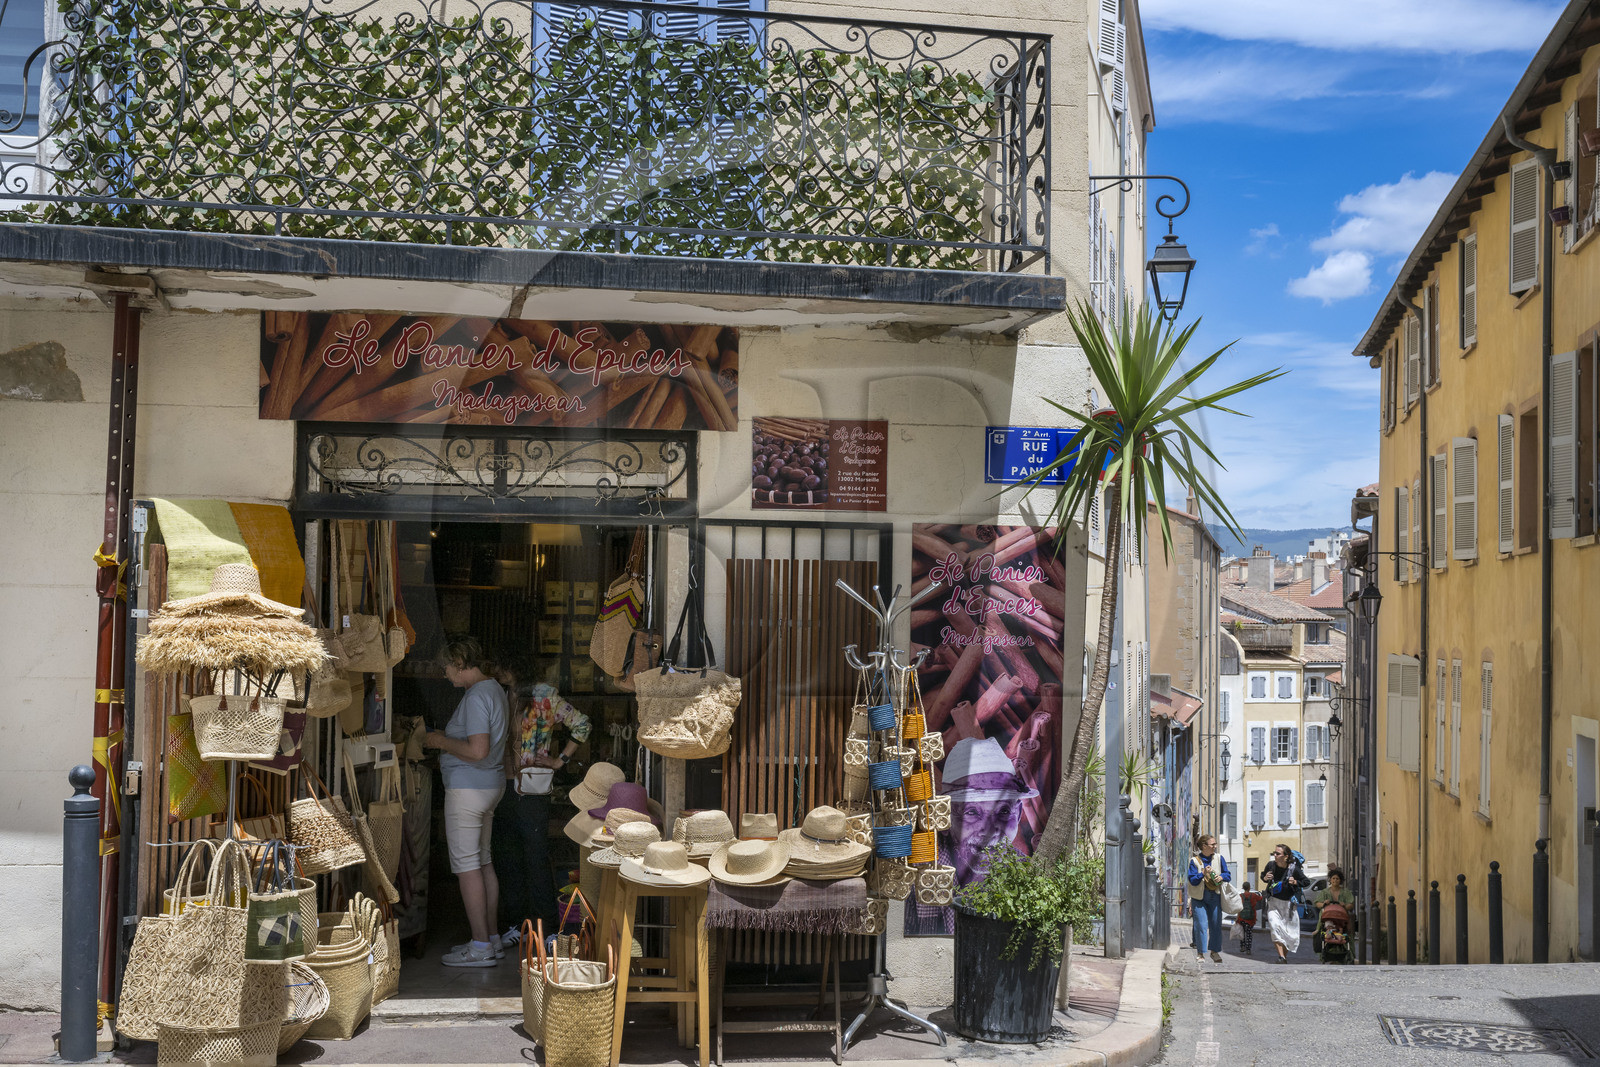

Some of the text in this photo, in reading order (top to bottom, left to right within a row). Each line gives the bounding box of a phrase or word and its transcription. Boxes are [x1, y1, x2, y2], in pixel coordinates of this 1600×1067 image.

[322, 318, 692, 388] Le Panier d'Epices
[431, 379, 587, 425] Madagascar
[832, 426, 885, 442] Le Panier
[838, 440, 882, 458] d'Epices
[1022, 441, 1048, 452] RUE
[1027, 453, 1043, 464] du
[1011, 466, 1059, 477] PANR
[928, 552, 1049, 587] Le Panier
[942, 585, 1042, 622] d'Epices
[940, 625, 1035, 655] Madagascar
